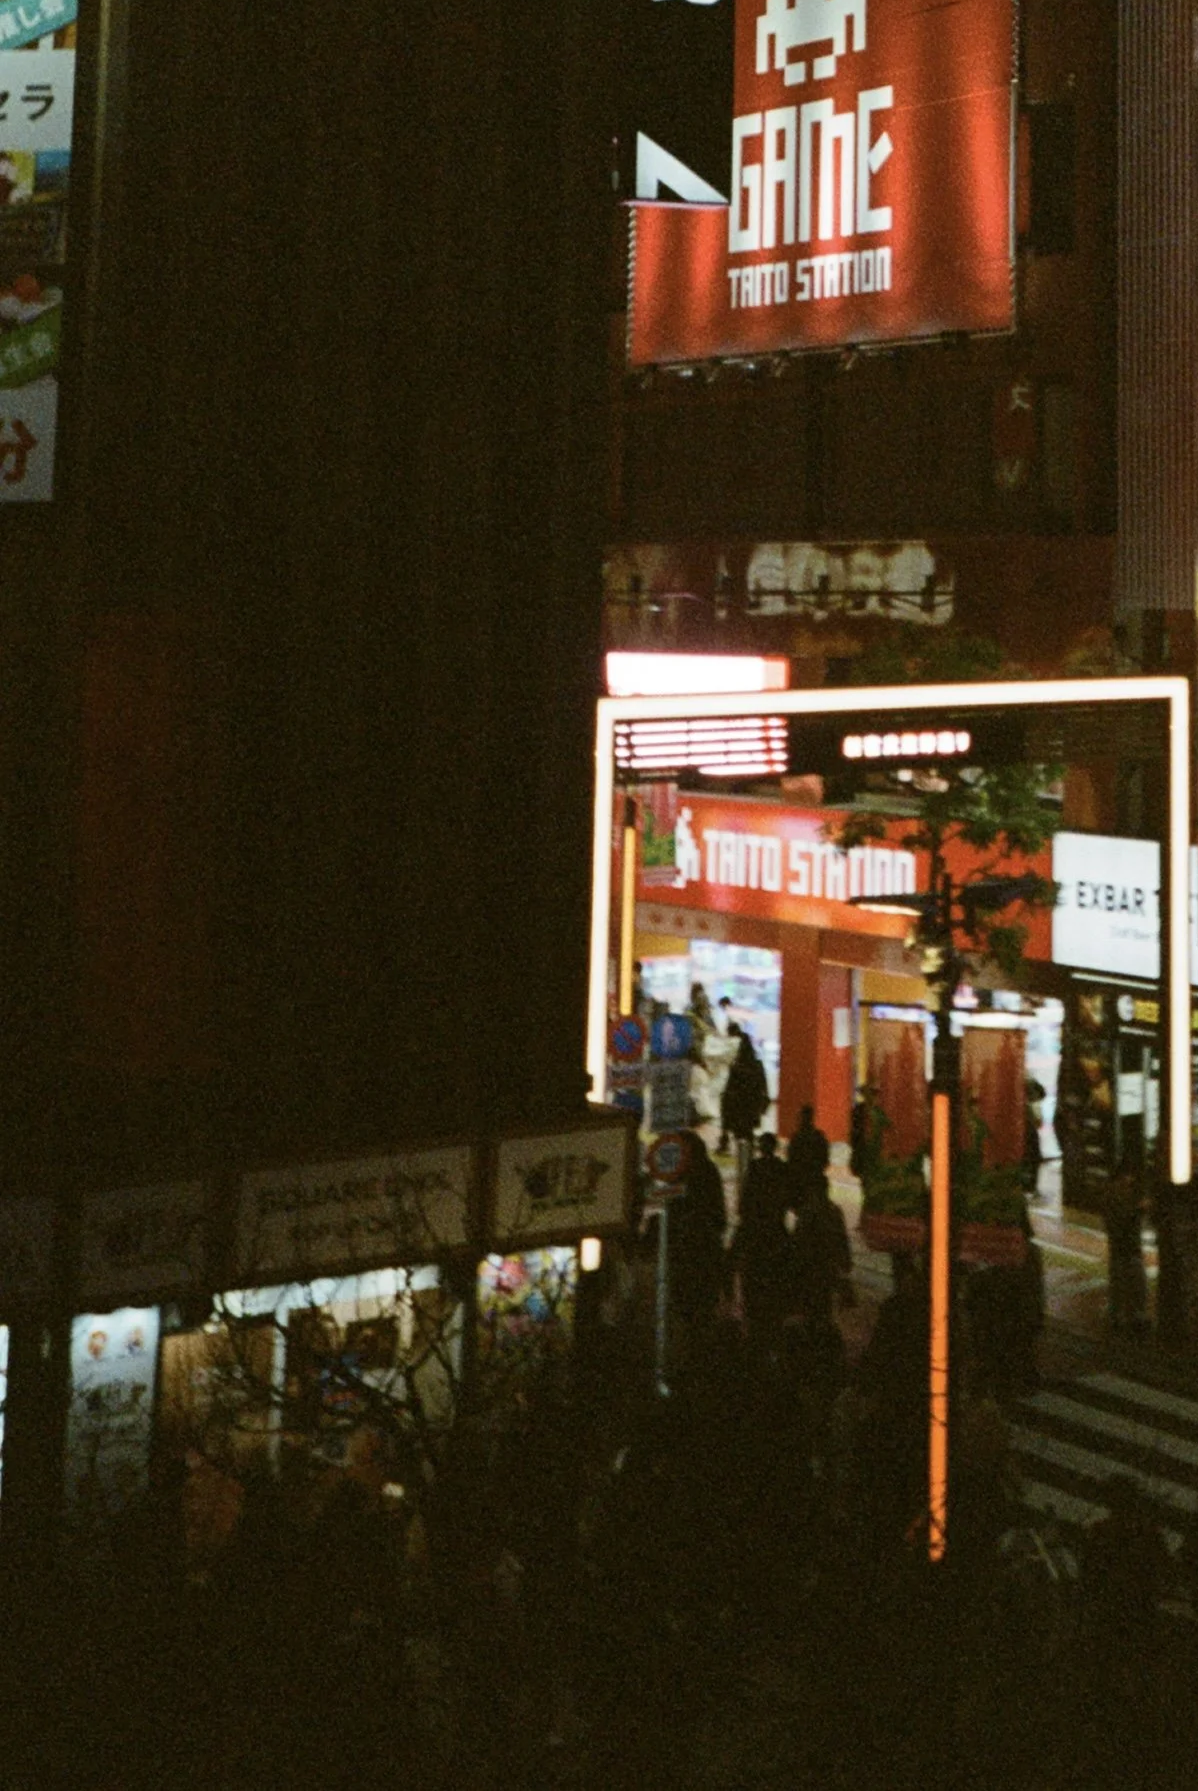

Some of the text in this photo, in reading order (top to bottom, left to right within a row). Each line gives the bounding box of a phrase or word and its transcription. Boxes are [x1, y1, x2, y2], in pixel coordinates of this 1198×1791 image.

[729, 85, 894, 254] GAME
[728, 246, 892, 309] TAITO STATION
[703, 828, 782, 892] TAITO
[1076, 880, 1145, 915] EXBAR
